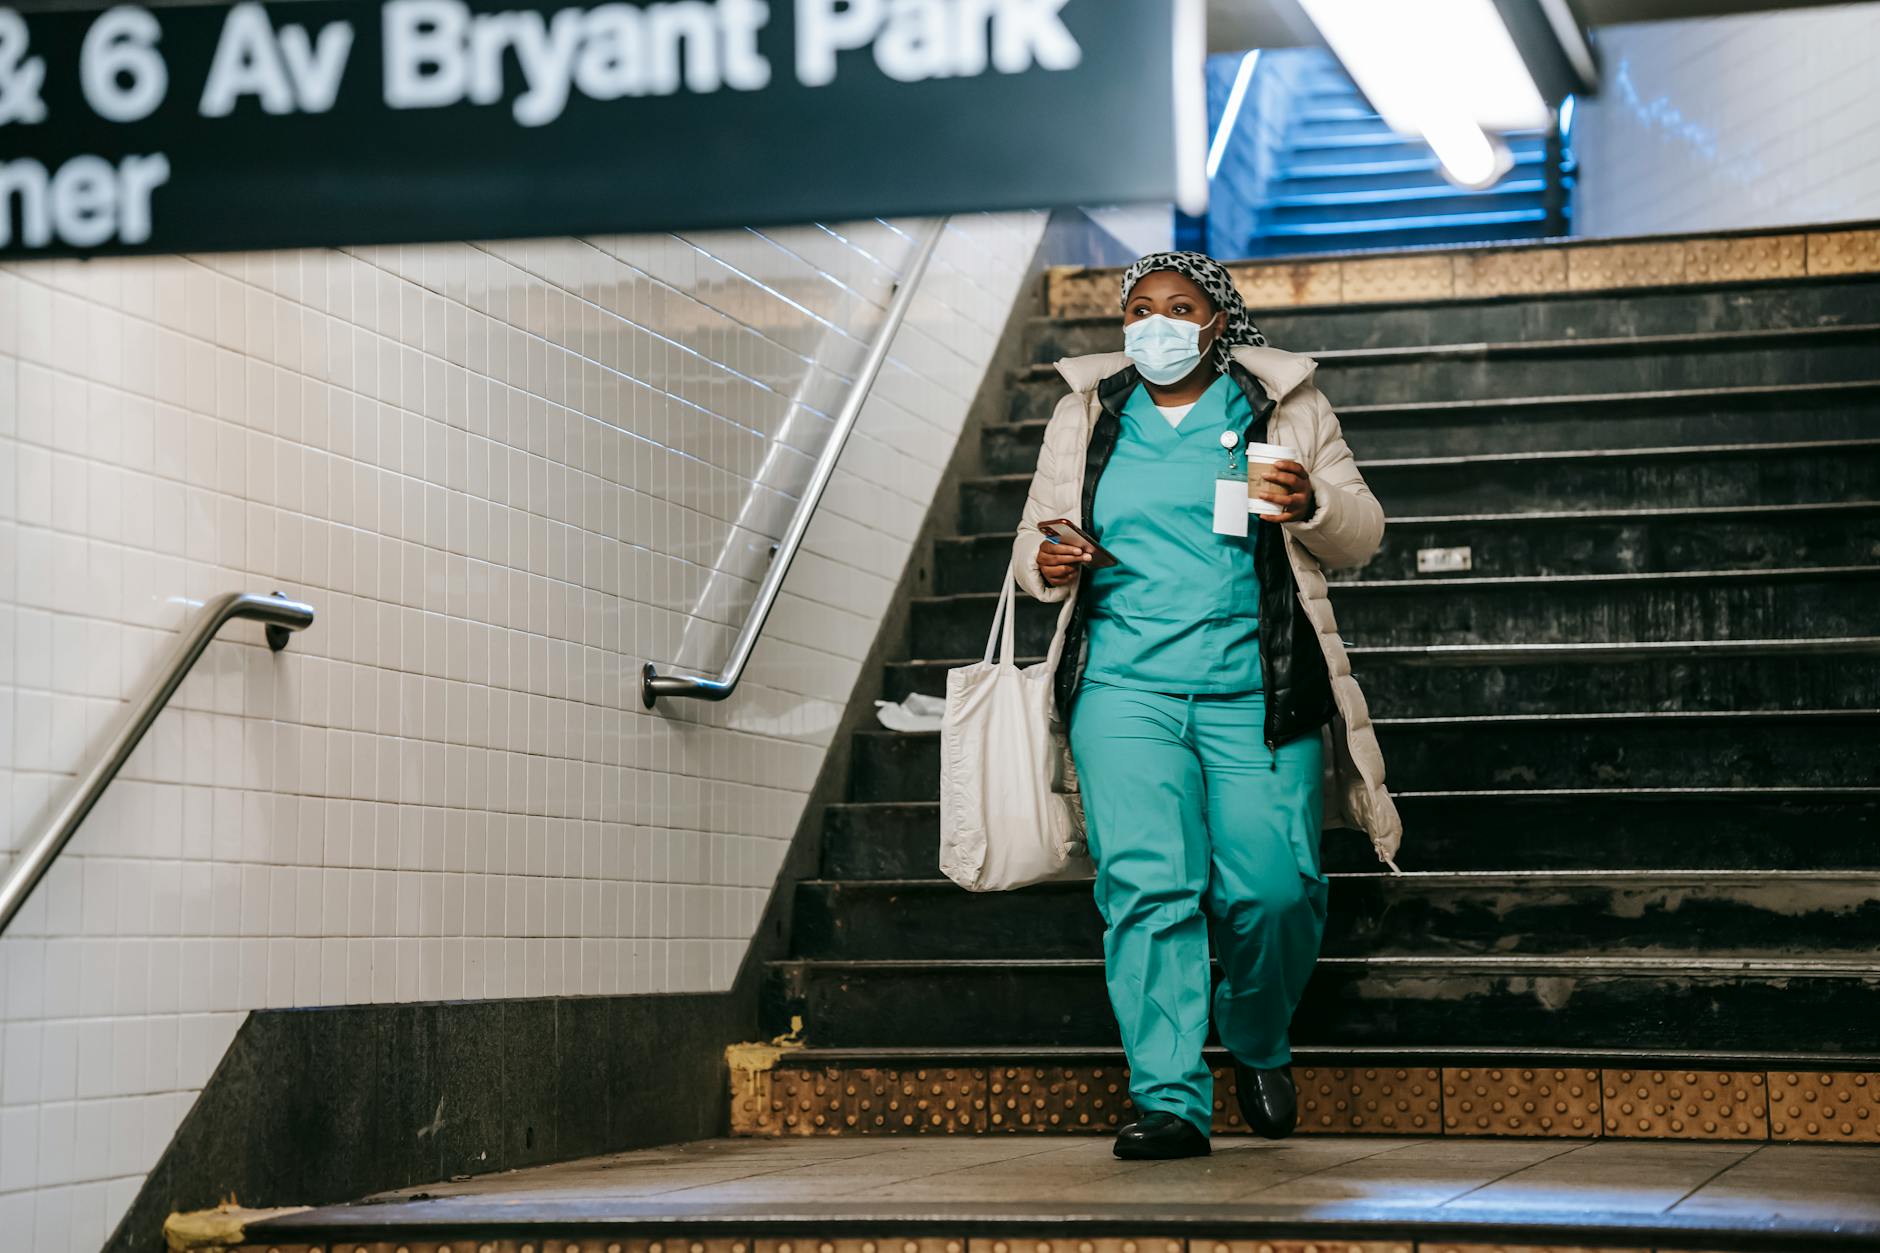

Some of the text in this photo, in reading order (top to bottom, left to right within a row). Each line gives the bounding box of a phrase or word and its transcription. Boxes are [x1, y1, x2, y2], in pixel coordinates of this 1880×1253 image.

[81, 4, 167, 121] 6
[200, 2, 353, 117] Av
[383, 0, 770, 126] Bryant
[796, 0, 1082, 87] Park
